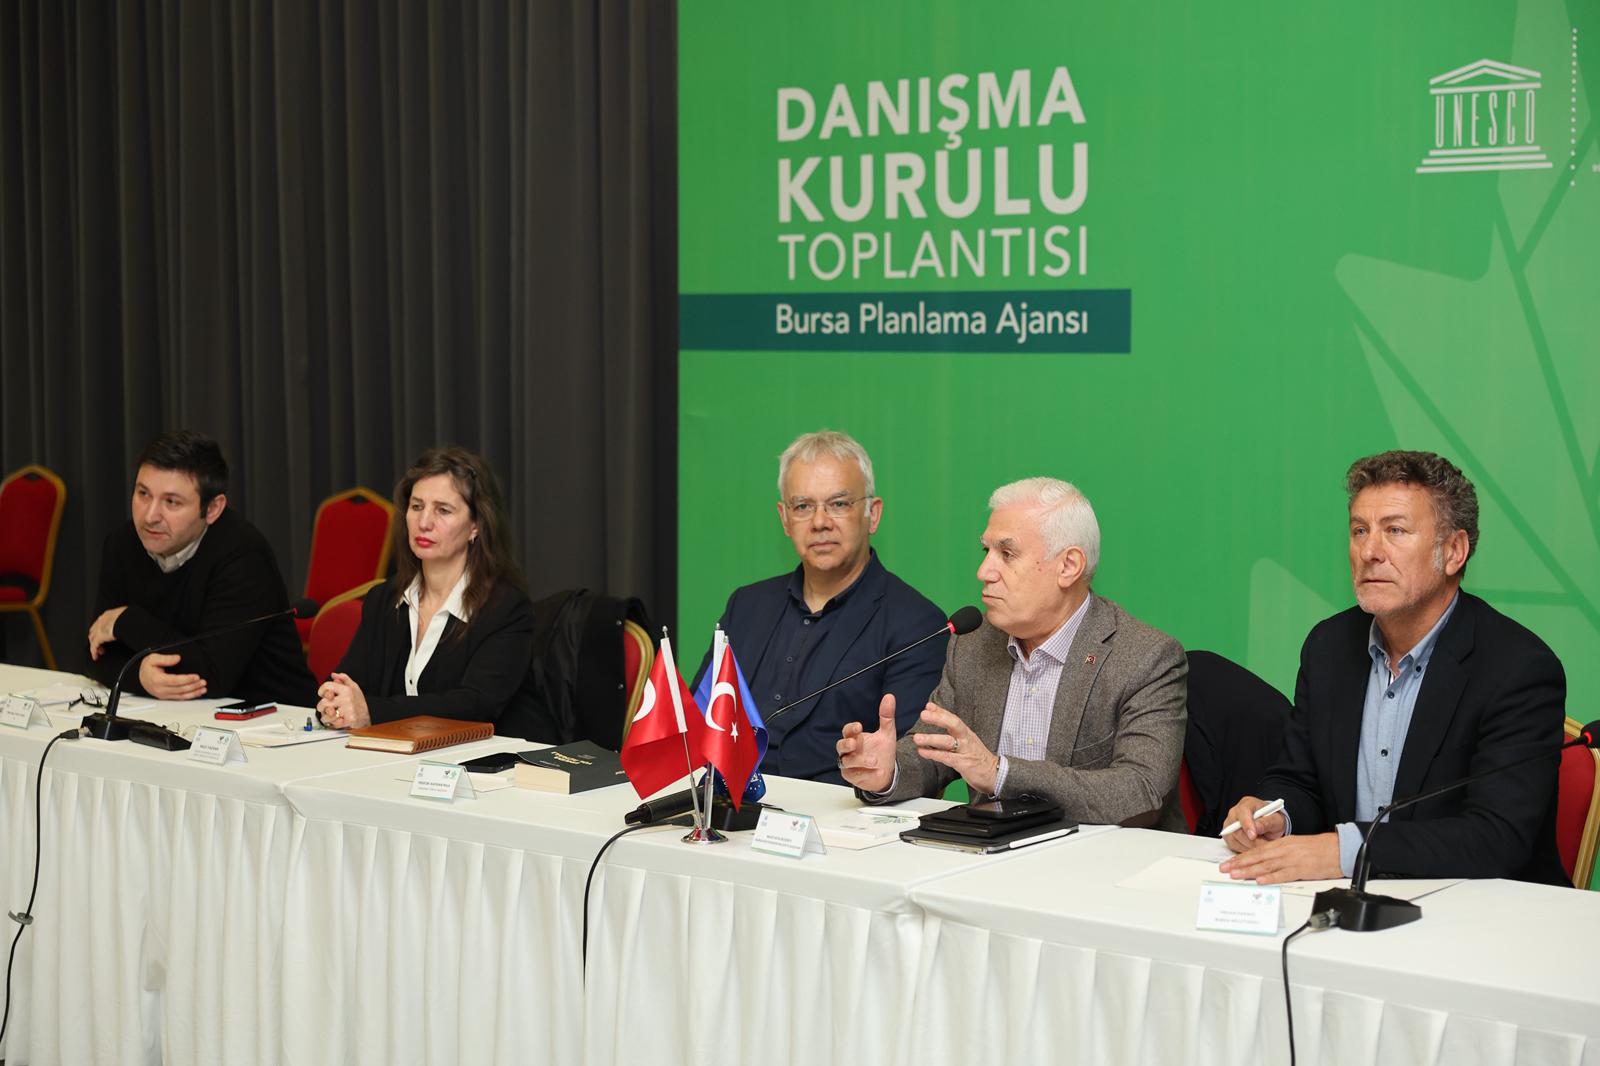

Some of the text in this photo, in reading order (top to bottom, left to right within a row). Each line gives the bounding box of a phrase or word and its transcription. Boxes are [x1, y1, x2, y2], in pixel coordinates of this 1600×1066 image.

[777, 66, 1087, 149] DANIŞMA
[1436, 90, 1534, 147] UNESCO
[778, 142, 1088, 223] KURULU
[778, 225, 1087, 280] TOPLANTISI
[776, 301, 1088, 343] Bursa Planlama Ajansı
